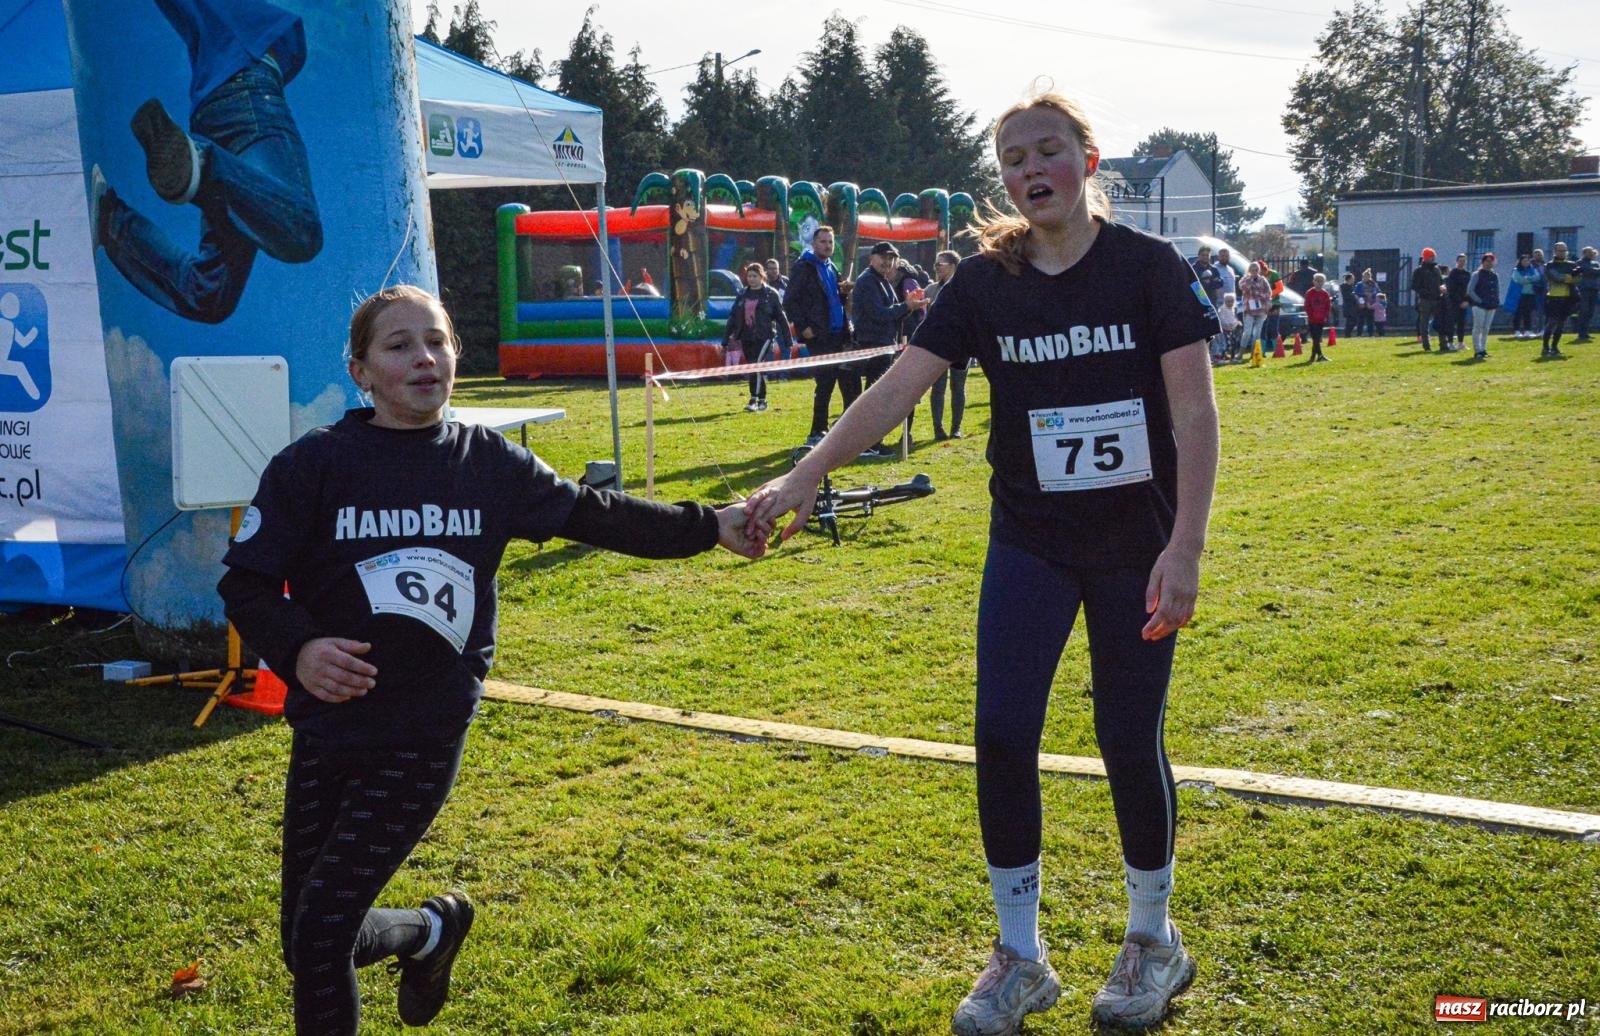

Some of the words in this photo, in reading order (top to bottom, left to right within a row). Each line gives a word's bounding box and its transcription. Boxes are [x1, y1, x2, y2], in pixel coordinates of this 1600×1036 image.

[553, 144, 584, 161] MITKO
[0, 219, 51, 270] st
[1068, 408, 1140, 424] www.personalbest.pl
[1055, 433, 1124, 475] 75
[395, 570, 457, 624] 64
